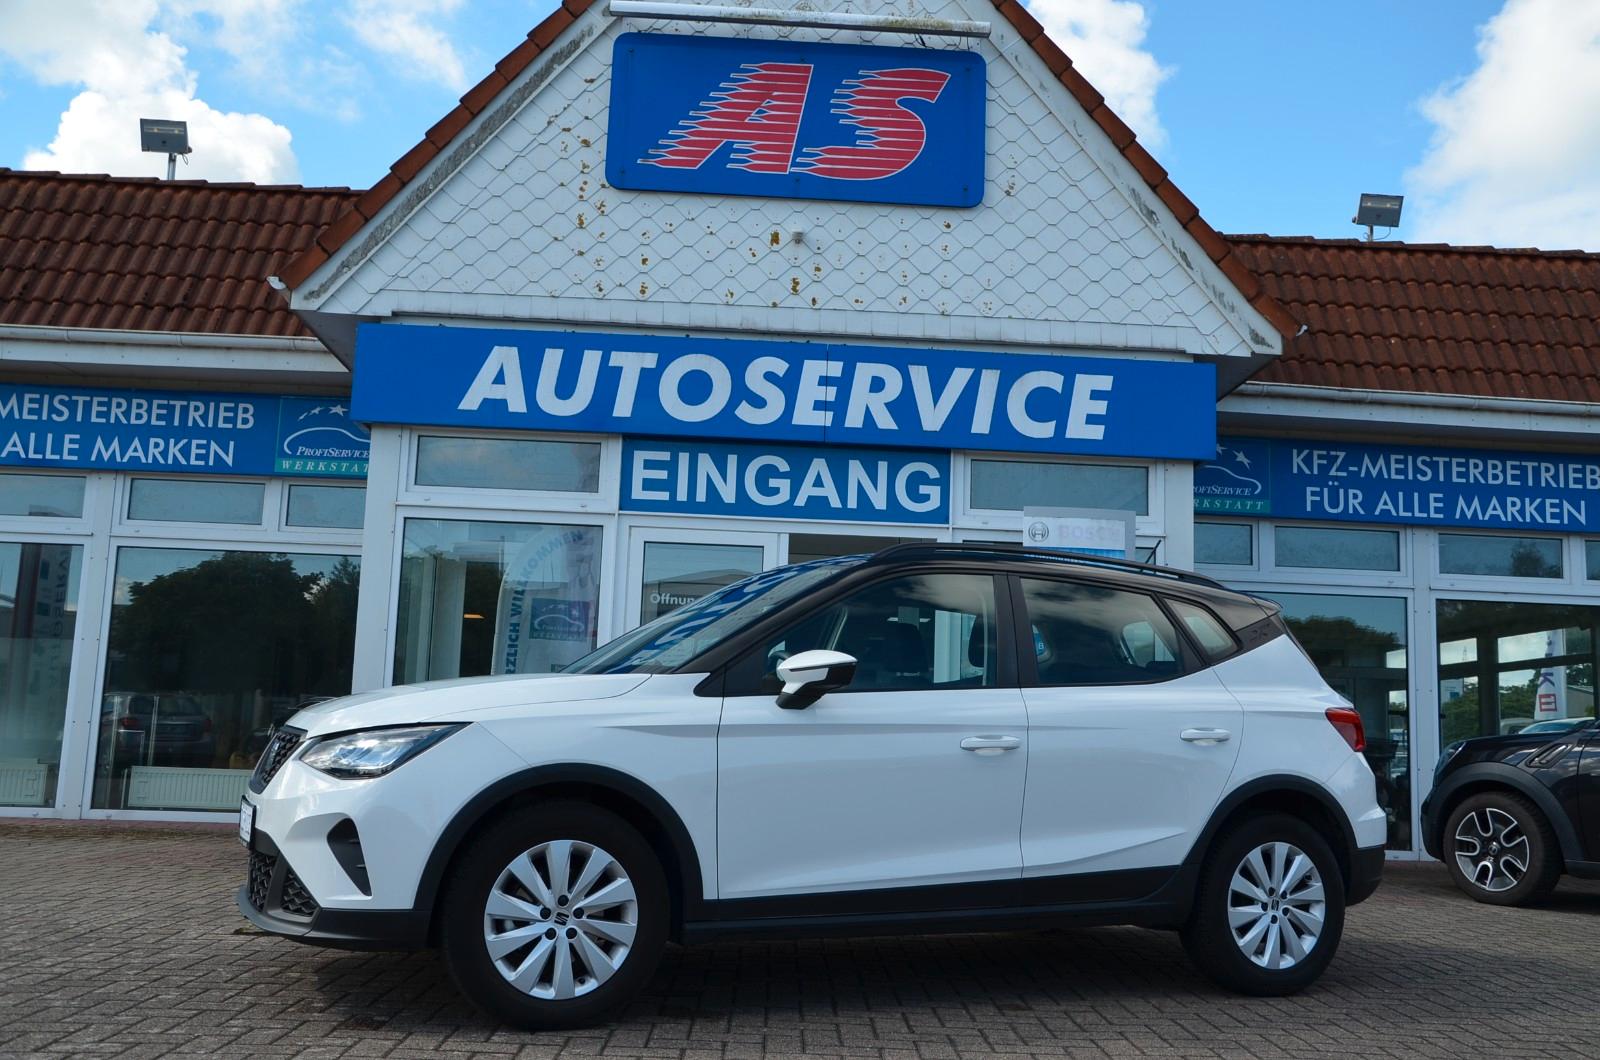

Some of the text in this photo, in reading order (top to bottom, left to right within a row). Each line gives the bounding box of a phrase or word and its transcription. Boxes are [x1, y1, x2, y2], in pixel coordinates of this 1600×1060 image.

[637, 62, 951, 181] AS
[457, 345, 1114, 441] AUTOSERVICE
[0, 431, 235, 468] ALLE MARKEN
[282, 459, 369, 473] WERKSTAT
[1292, 448, 1600, 490] KFZ-MEISTERBETRIEB
[630, 450, 941, 513] EINGANG
[1193, 484, 1252, 496] OFISERVICE
[1305, 480, 1586, 526] FÜR ALLE MARKEN
[650, 590, 695, 605] Öffnun
